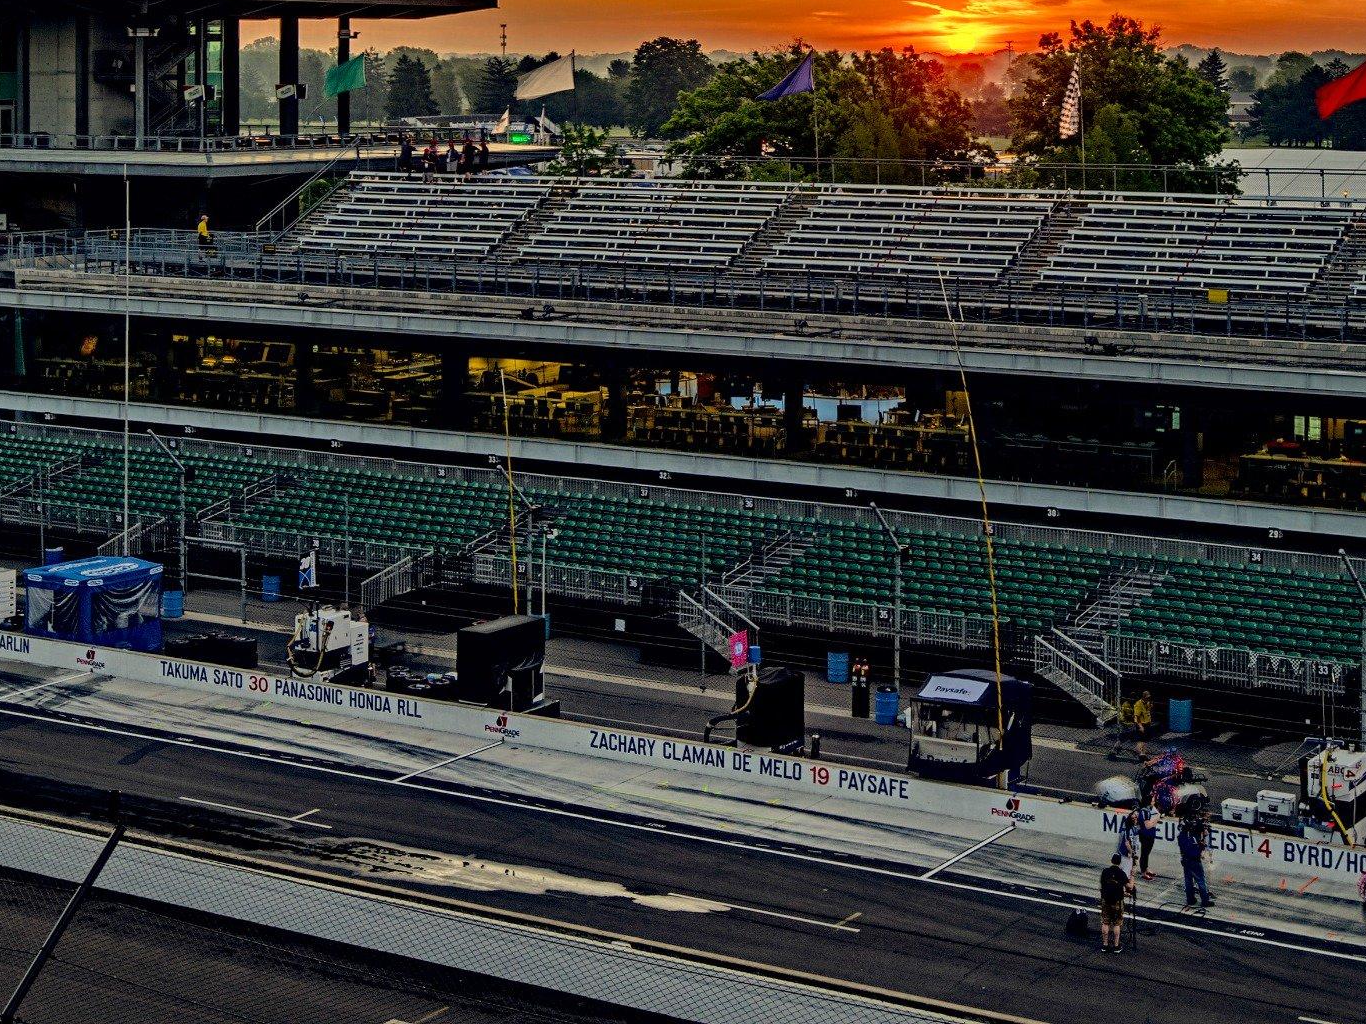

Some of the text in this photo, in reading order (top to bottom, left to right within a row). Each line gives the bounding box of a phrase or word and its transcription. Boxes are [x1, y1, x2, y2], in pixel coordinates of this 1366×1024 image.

[160, 659, 422, 719] TAKUMA SATO 30 PANASONIC HONDA RLL
[589, 730, 909, 800] ZACHARY CLAMAN DE MELO 19 PAYSAFE
[1257, 839, 1272, 858] 4
